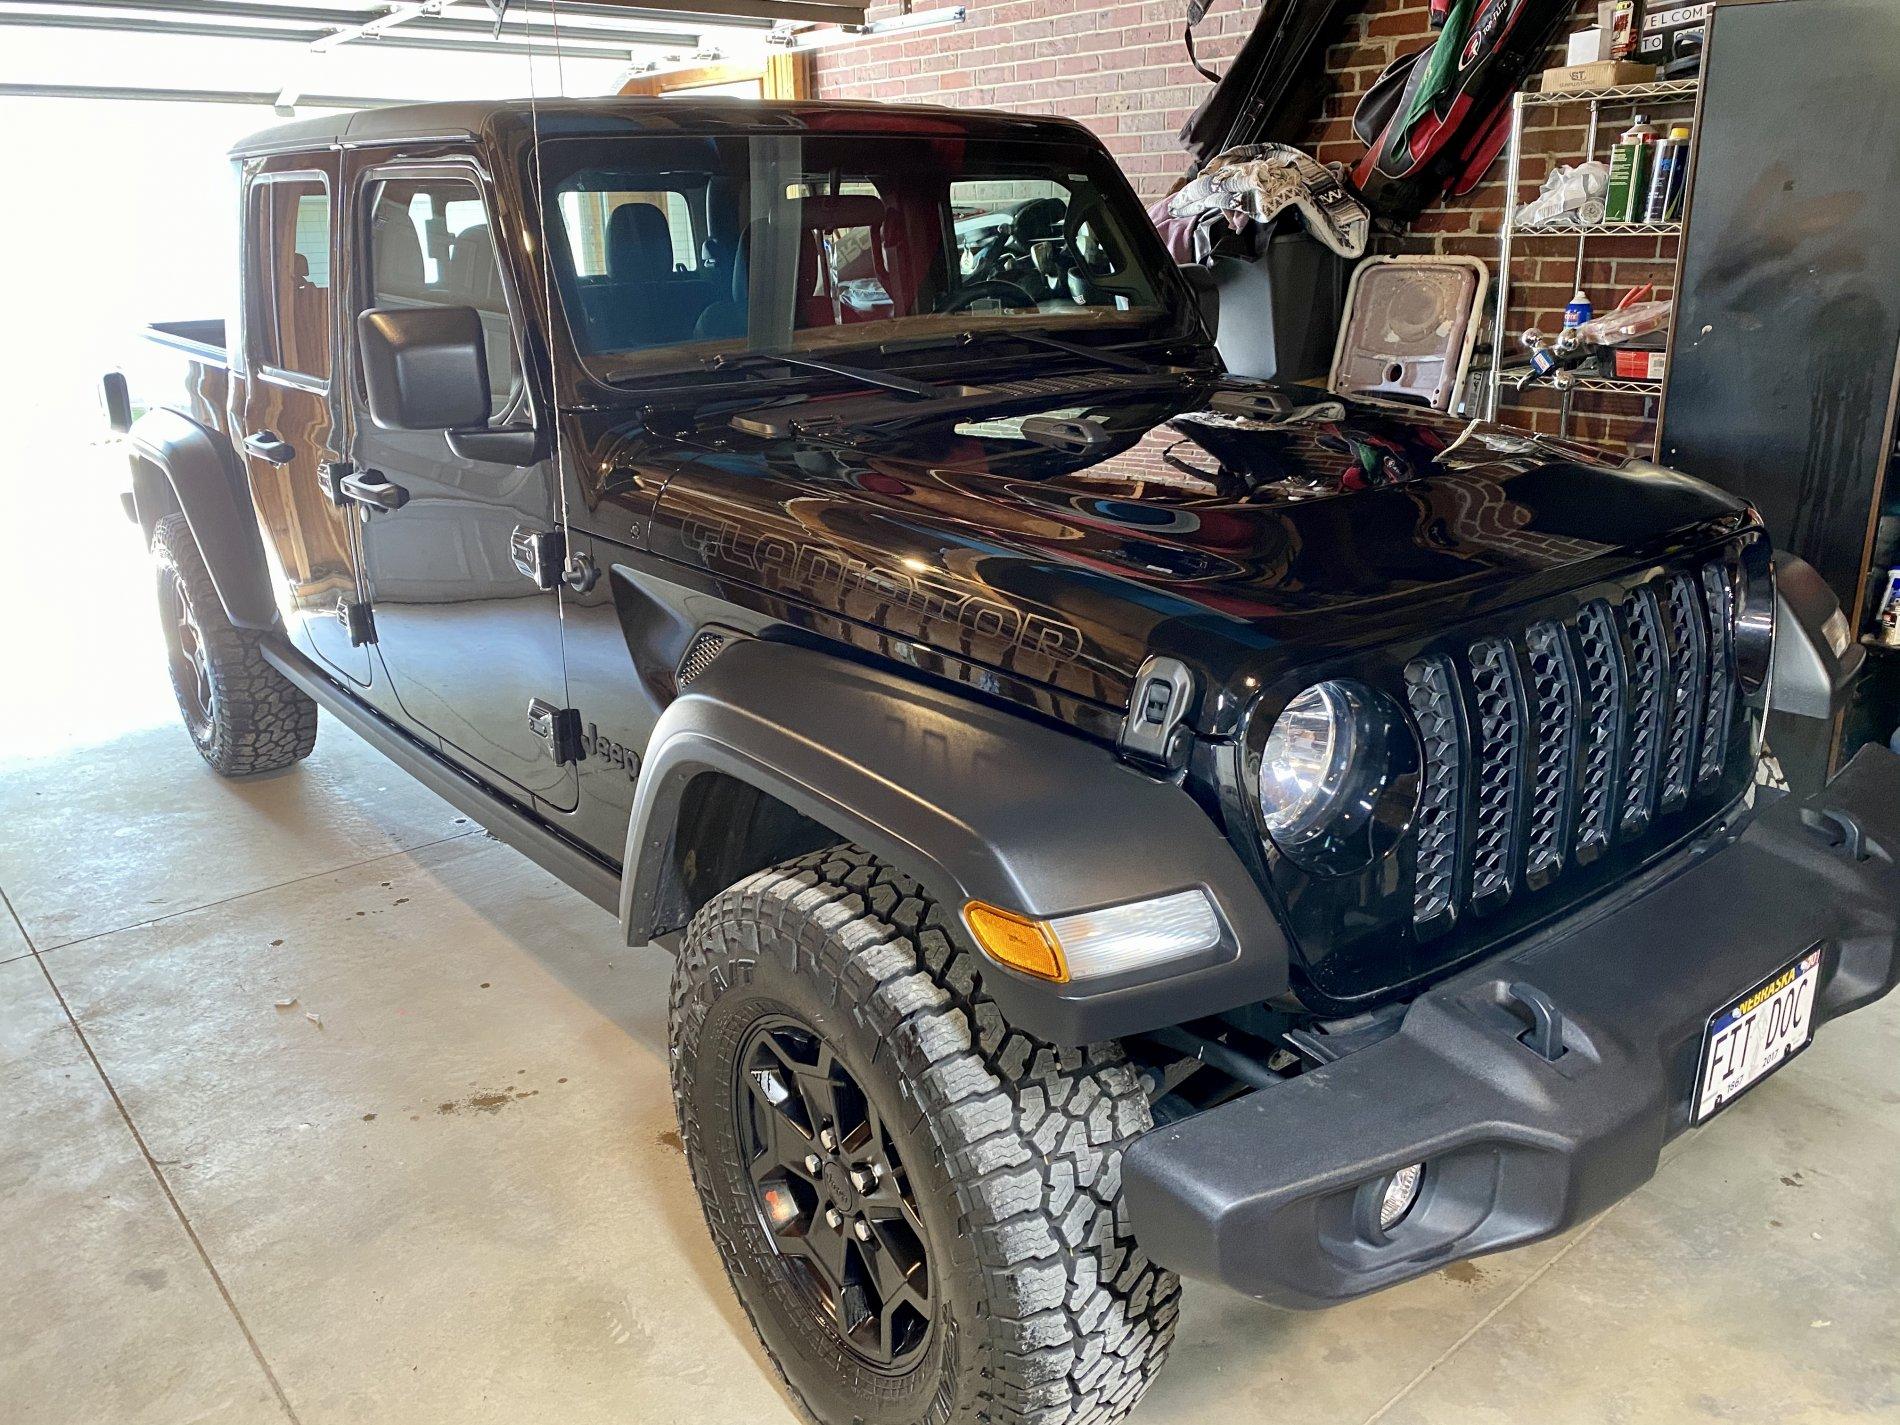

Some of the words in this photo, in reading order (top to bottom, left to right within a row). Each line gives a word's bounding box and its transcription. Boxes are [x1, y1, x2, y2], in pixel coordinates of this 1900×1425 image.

[1644, 6, 1703, 27] ELCOM
[1643, 37, 1662, 50] TO
[681, 511, 1083, 664] GLADIATOR
[581, 722, 642, 782] Jeep
[1738, 967, 1796, 1015] NEBRASKA
[1707, 1013, 1757, 1093] FIT
[1764, 978, 1809, 1050] DOC
[1762, 1049, 1780, 1068] 2017
